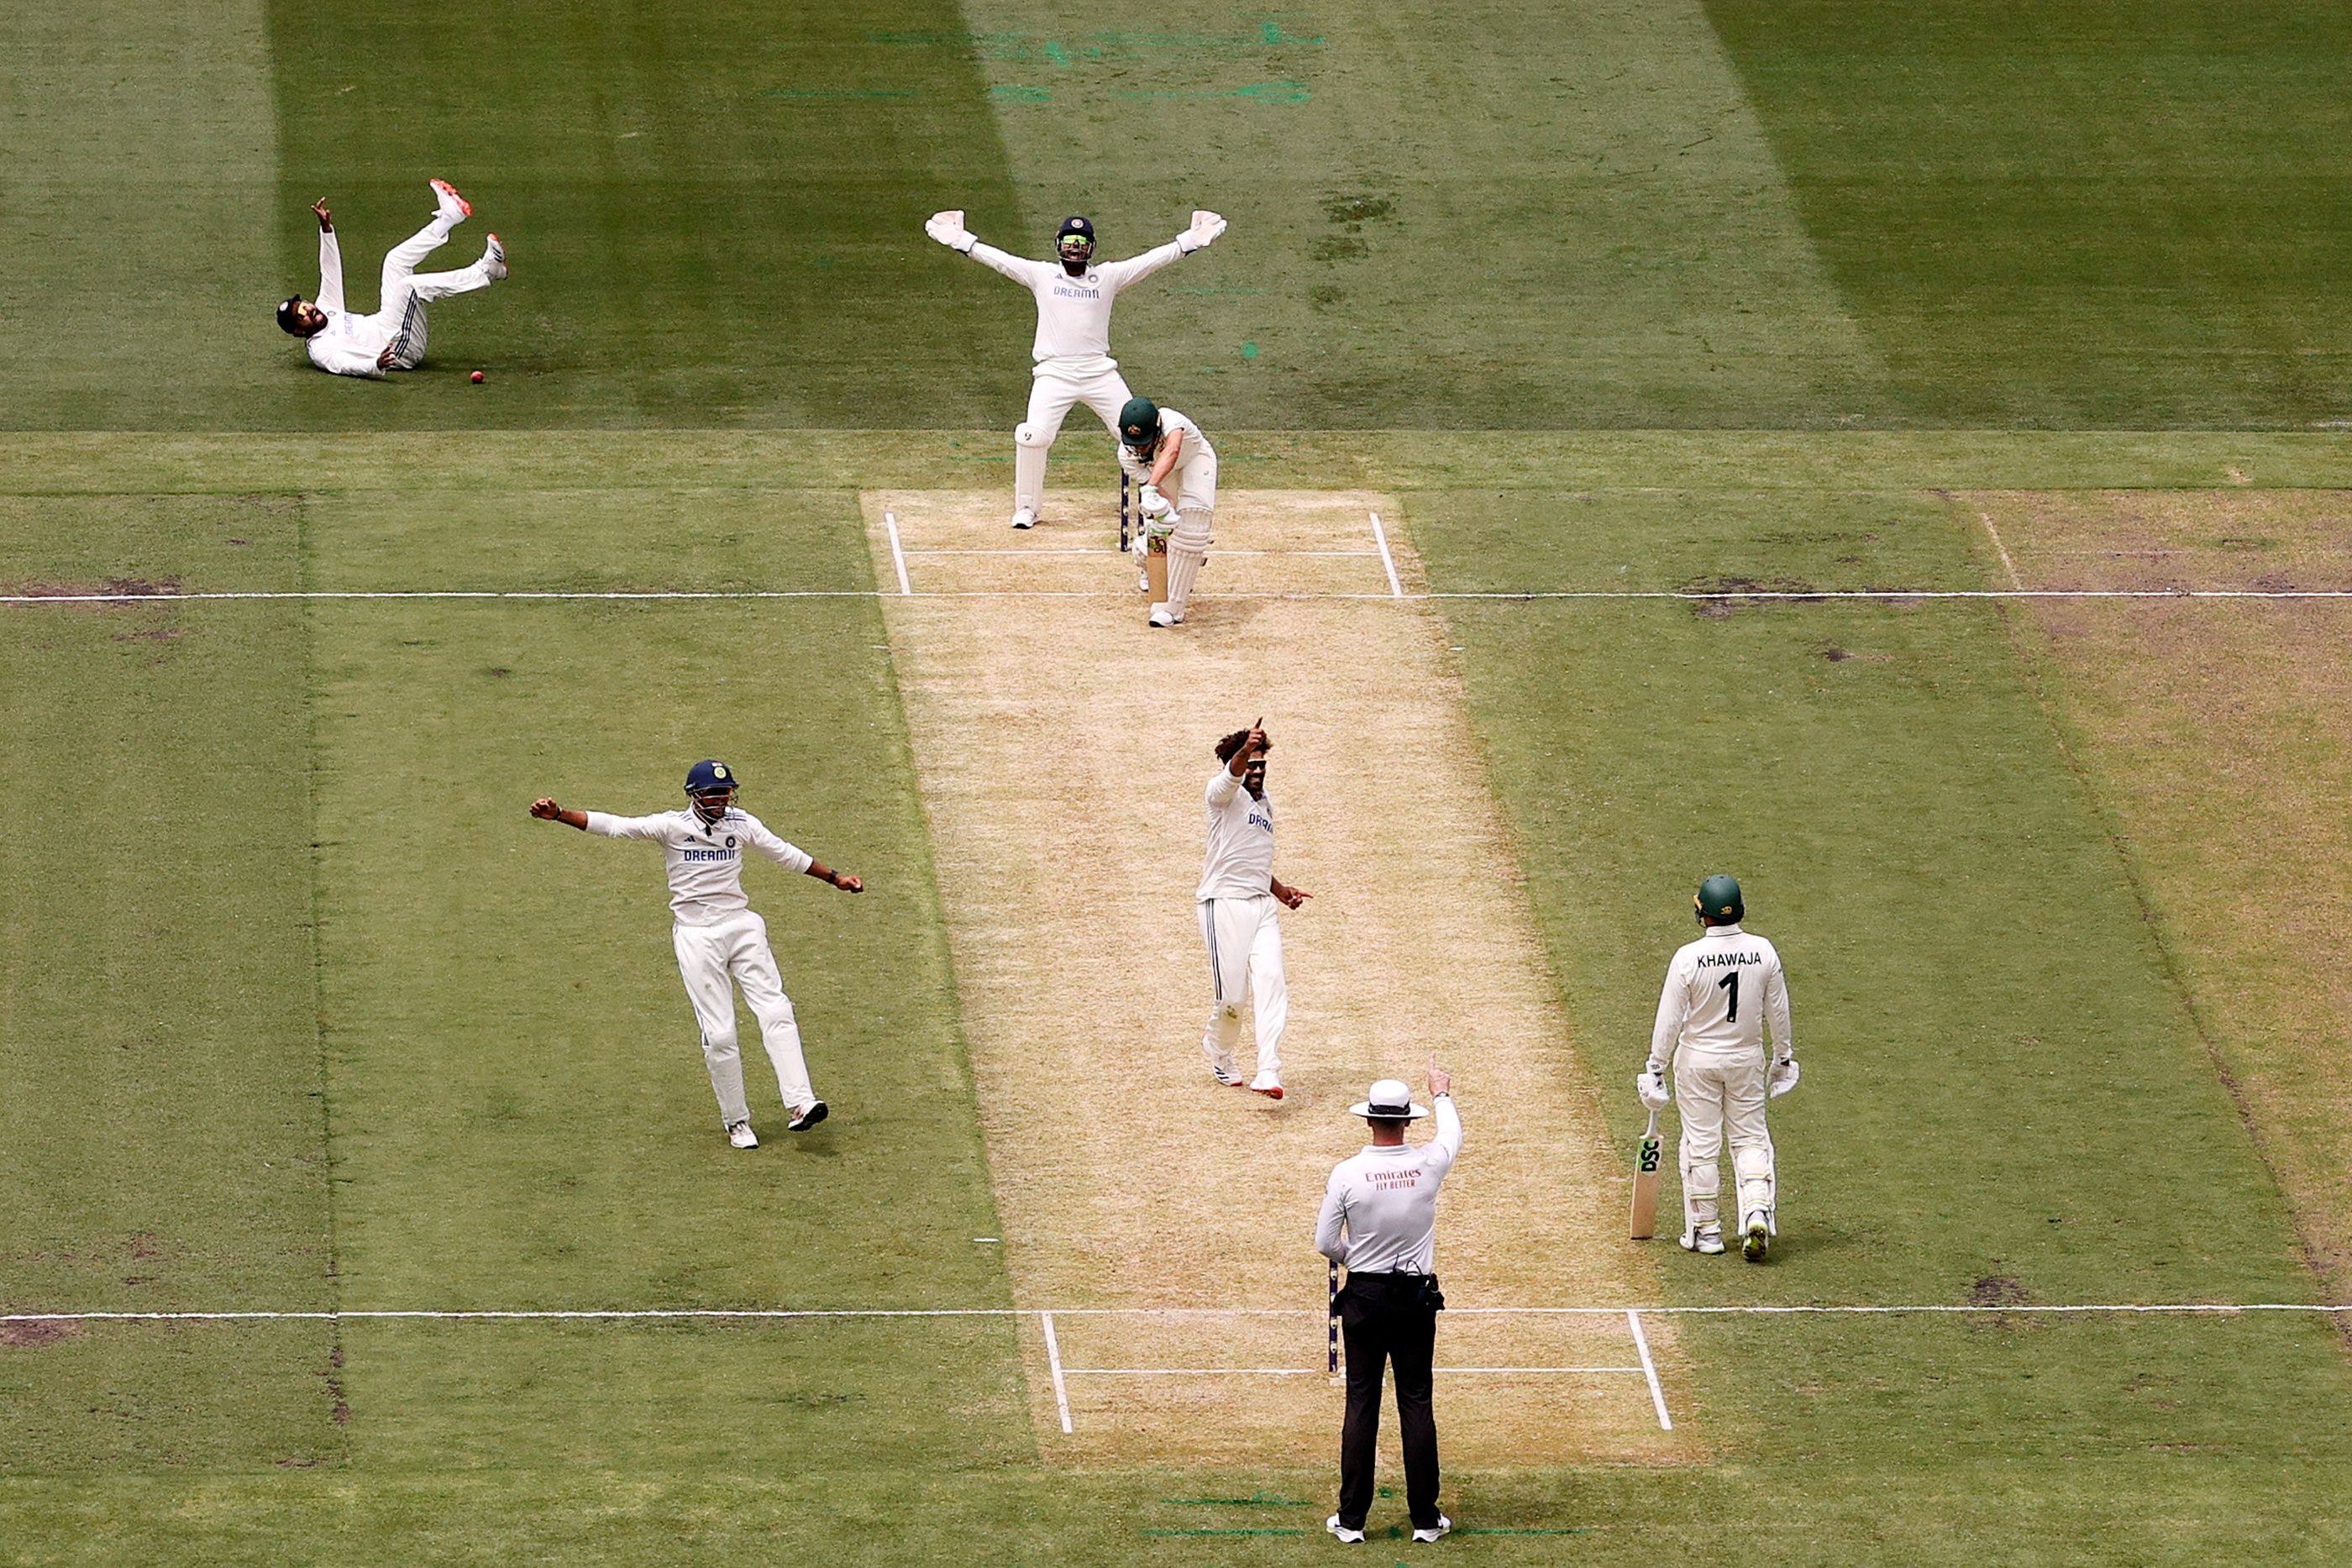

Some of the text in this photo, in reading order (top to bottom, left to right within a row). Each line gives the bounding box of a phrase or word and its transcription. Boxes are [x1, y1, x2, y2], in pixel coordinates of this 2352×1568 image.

[1697, 952, 1761, 968] KHAWAJA
[1718, 971, 1739, 1023] 1
[1641, 1141, 1660, 1172] DSC
[1365, 1169, 1421, 1182] Emirates
[1376, 1179, 1415, 1191] FLY BETTER
